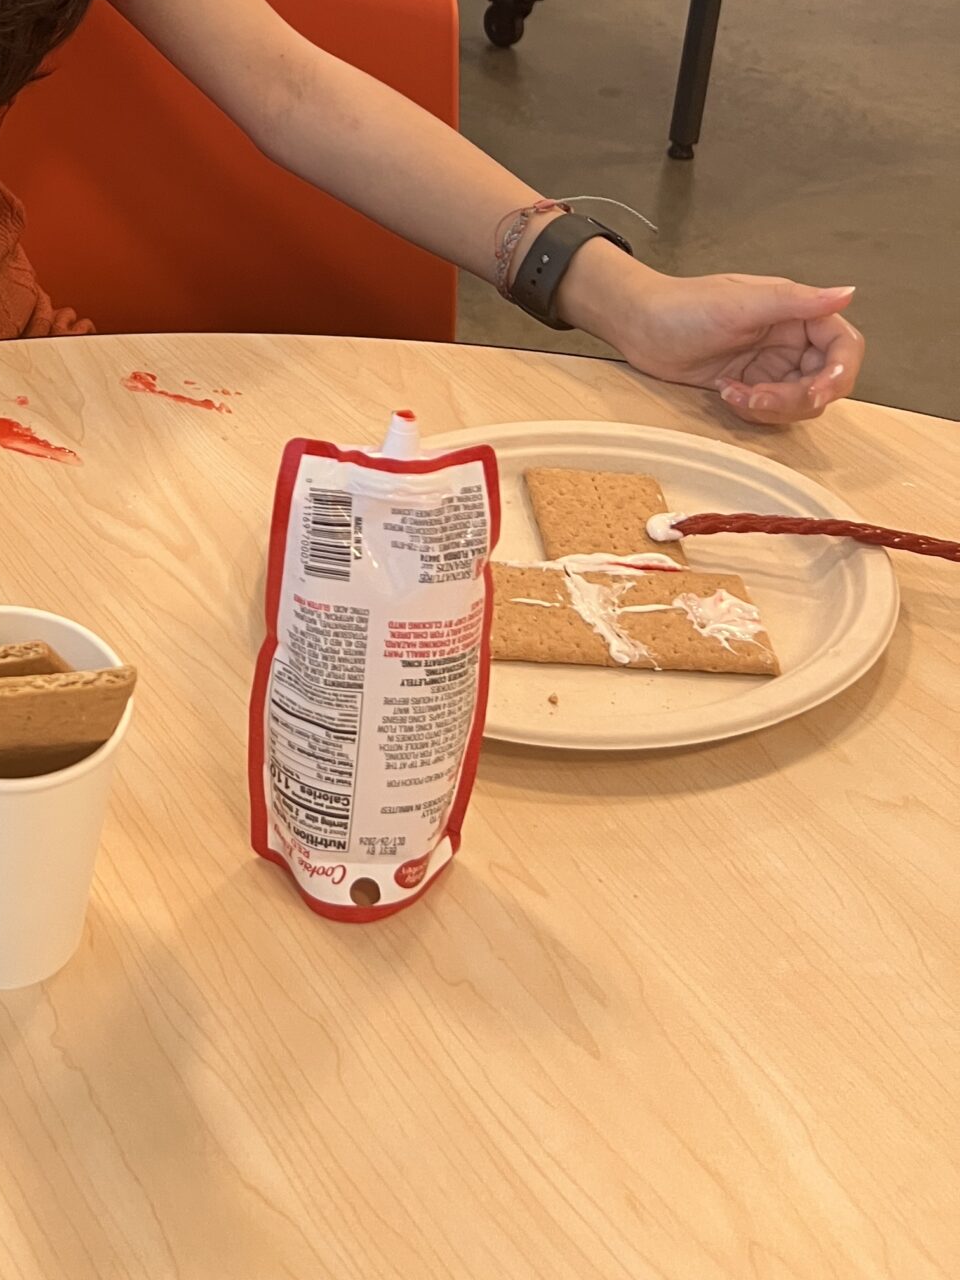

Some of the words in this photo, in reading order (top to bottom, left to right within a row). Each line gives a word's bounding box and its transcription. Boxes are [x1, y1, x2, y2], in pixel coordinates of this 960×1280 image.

[436, 560, 473, 573] BRANDS
[418, 570, 473, 584] SIGNATURE
[408, 621, 443, 630] CLICKING
[384, 650, 404, 658] PART
[406, 650, 431, 658] SMALL
[299, 785, 350, 807] Calories
[293, 826, 347, 851] Nutrition
[366, 847, 375, 855] BY
[379, 847, 397, 855] BEST
